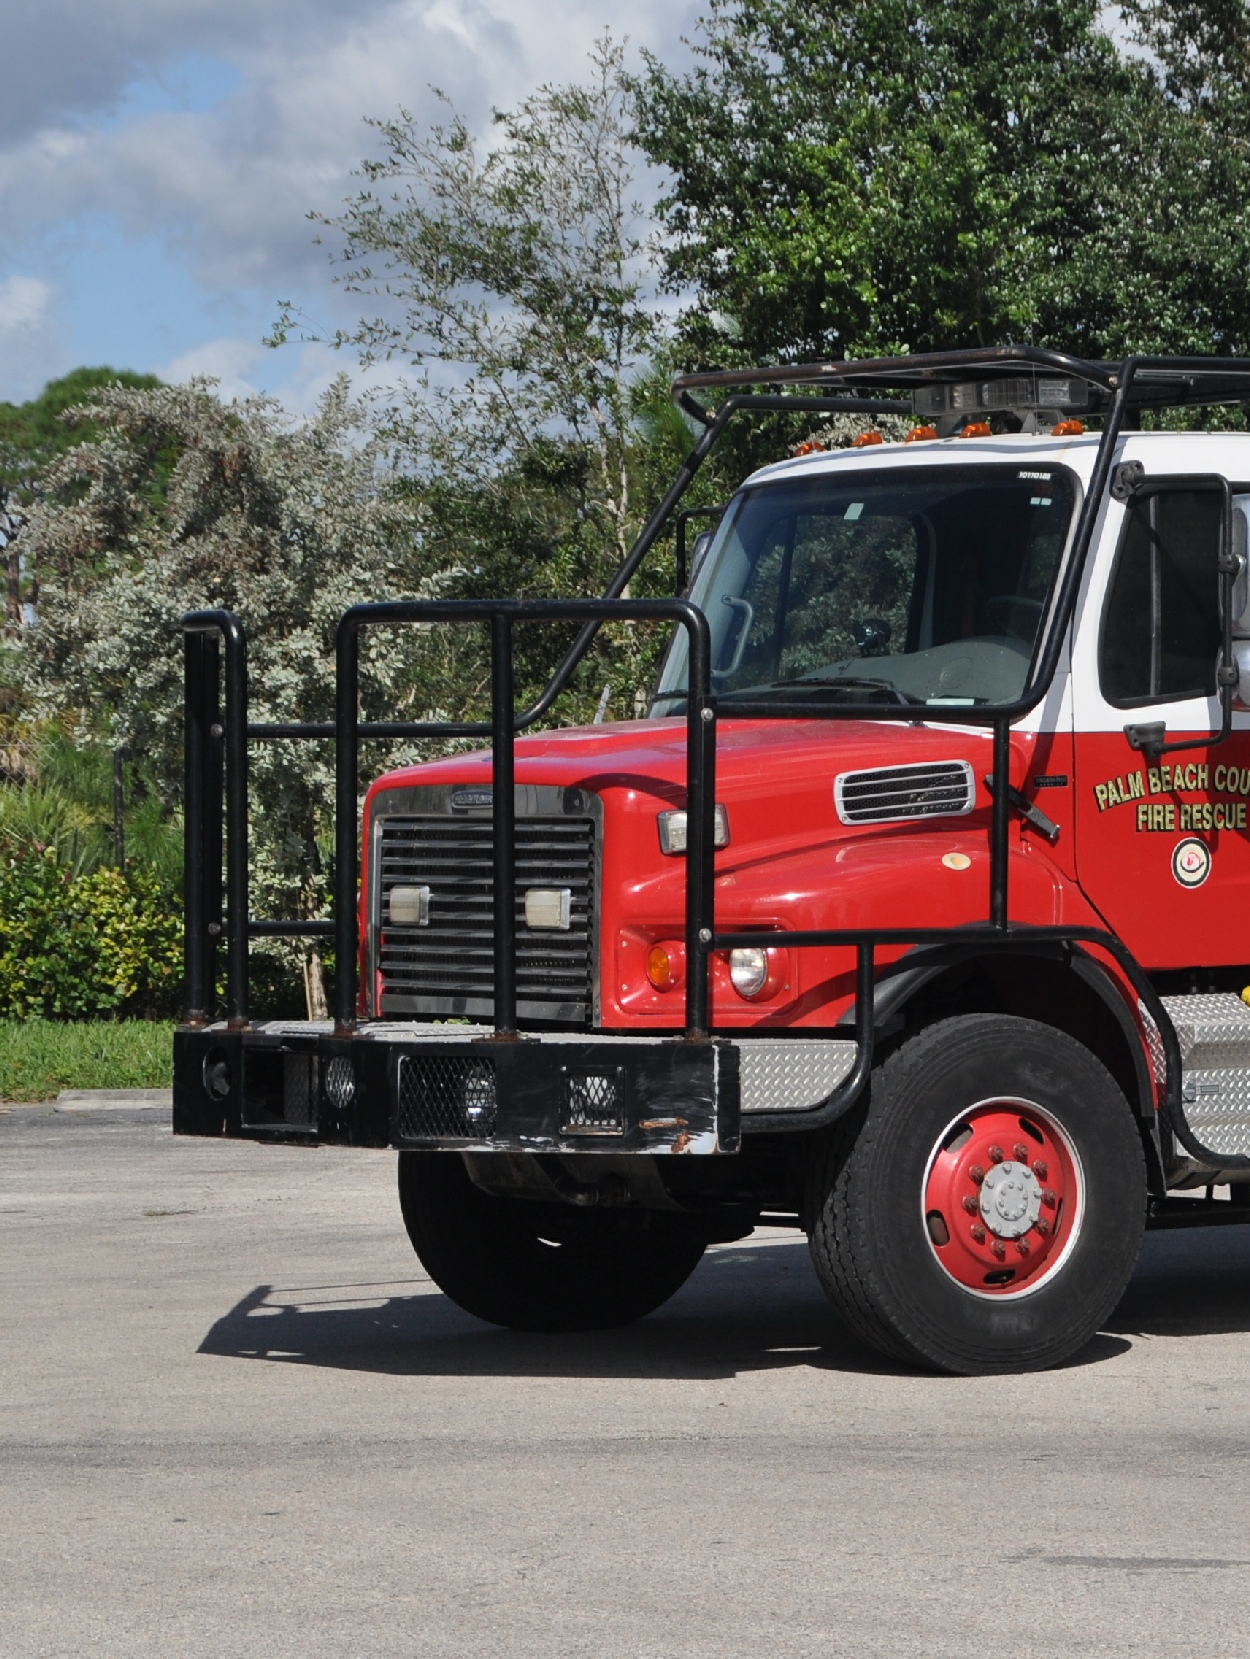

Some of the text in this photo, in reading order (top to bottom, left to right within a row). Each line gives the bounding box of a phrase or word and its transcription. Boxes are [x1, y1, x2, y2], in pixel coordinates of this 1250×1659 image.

[1094, 770, 1145, 812] PALM
[1147, 763, 1209, 795] BEACH
[1136, 803, 1247, 831] FIRE RESCUE
